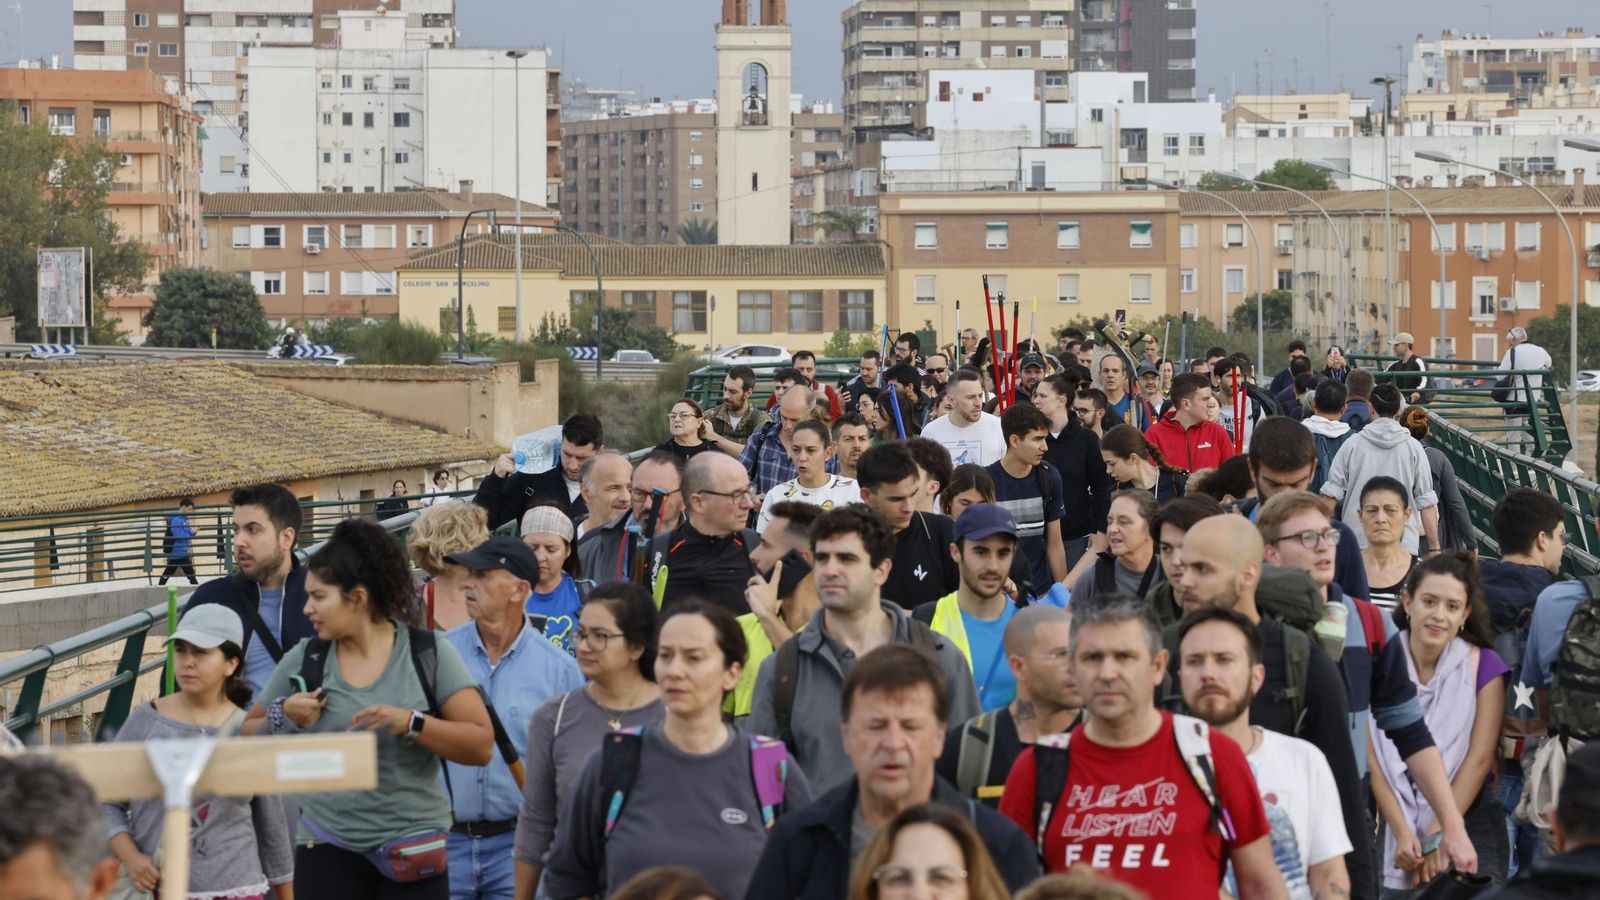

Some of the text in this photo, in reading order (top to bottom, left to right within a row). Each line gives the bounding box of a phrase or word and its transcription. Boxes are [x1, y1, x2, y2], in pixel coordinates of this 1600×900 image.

[1066, 783, 1178, 808] HEAR
[1061, 811, 1177, 837] LISTEN
[1065, 842, 1170, 868] FEEL
